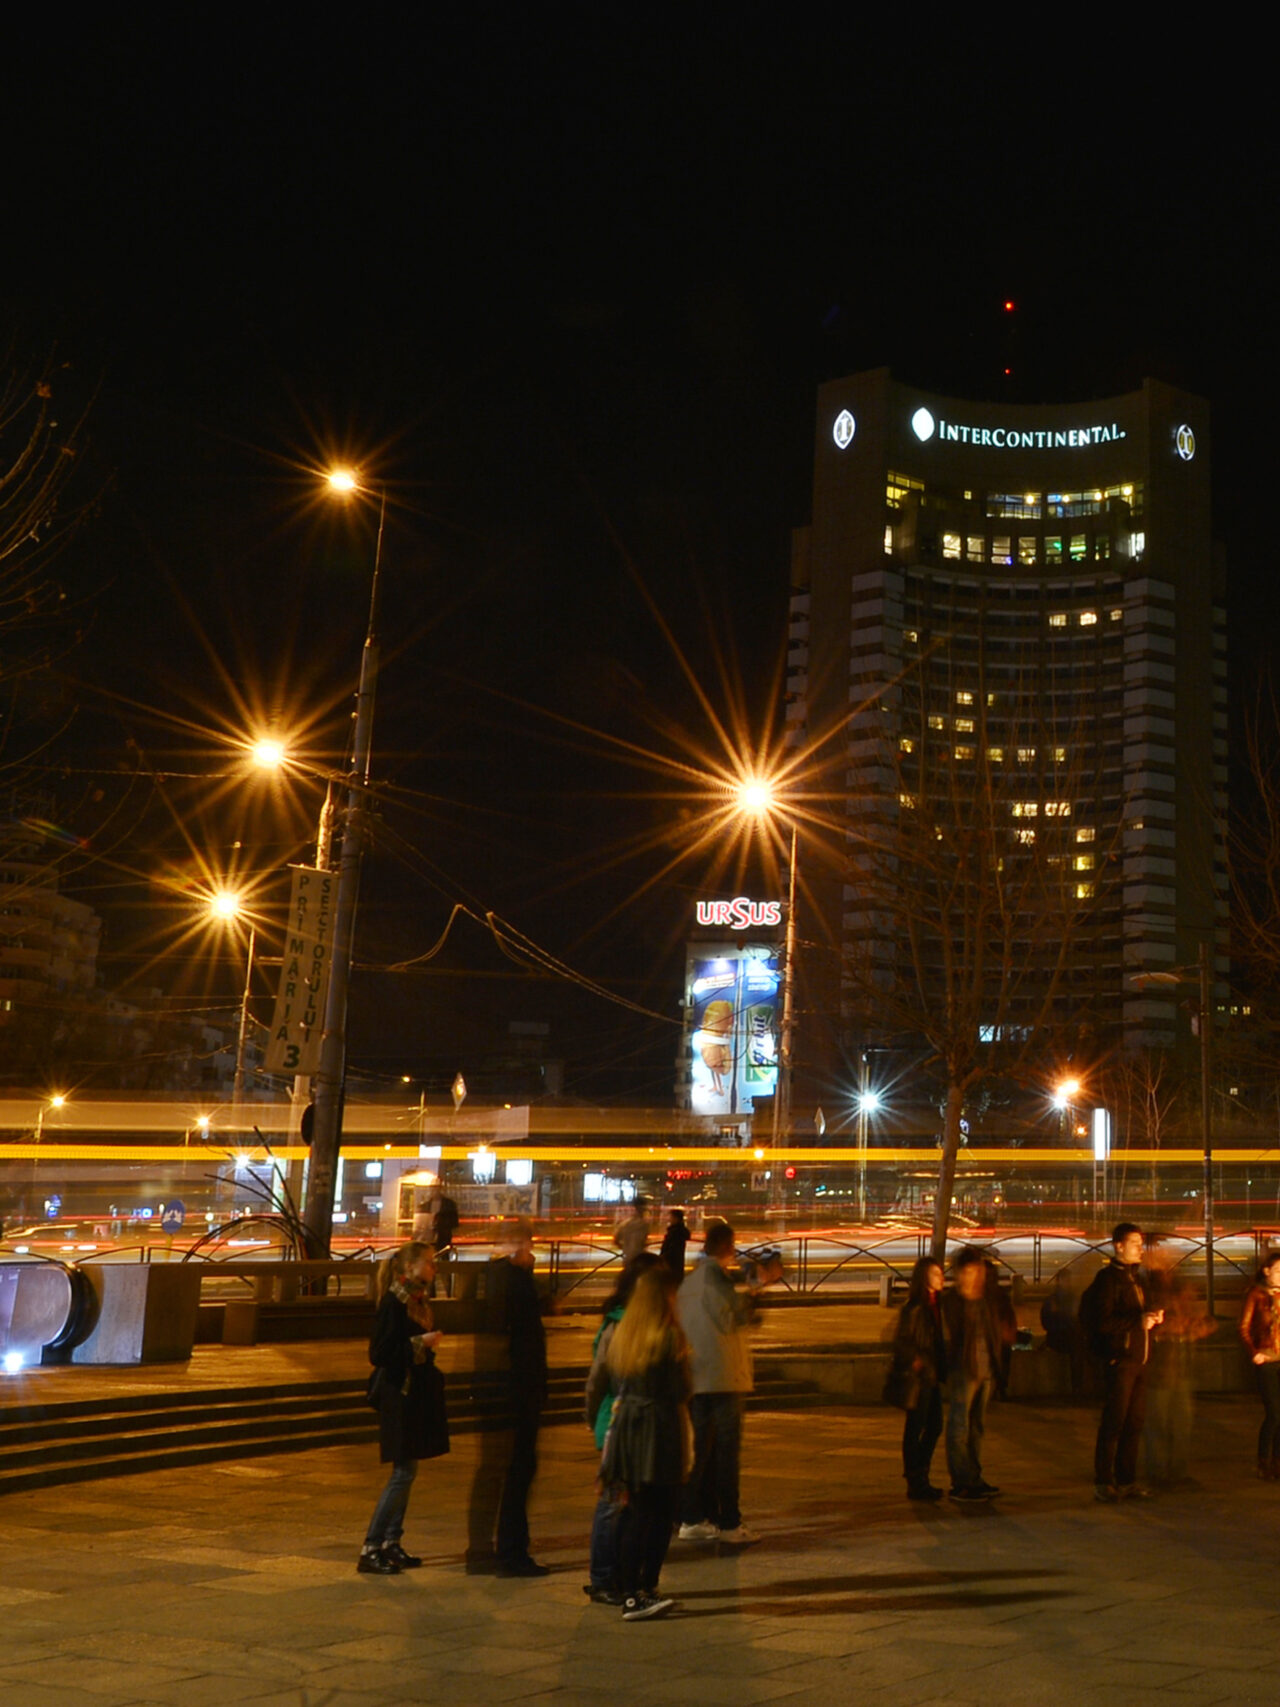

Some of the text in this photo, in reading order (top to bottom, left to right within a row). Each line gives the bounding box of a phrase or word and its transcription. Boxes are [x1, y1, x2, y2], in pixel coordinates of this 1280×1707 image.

[696, 897, 782, 930] URSUS
[303, 879, 330, 1043] SECTORULUI
[283, 1045, 300, 1068] 3
